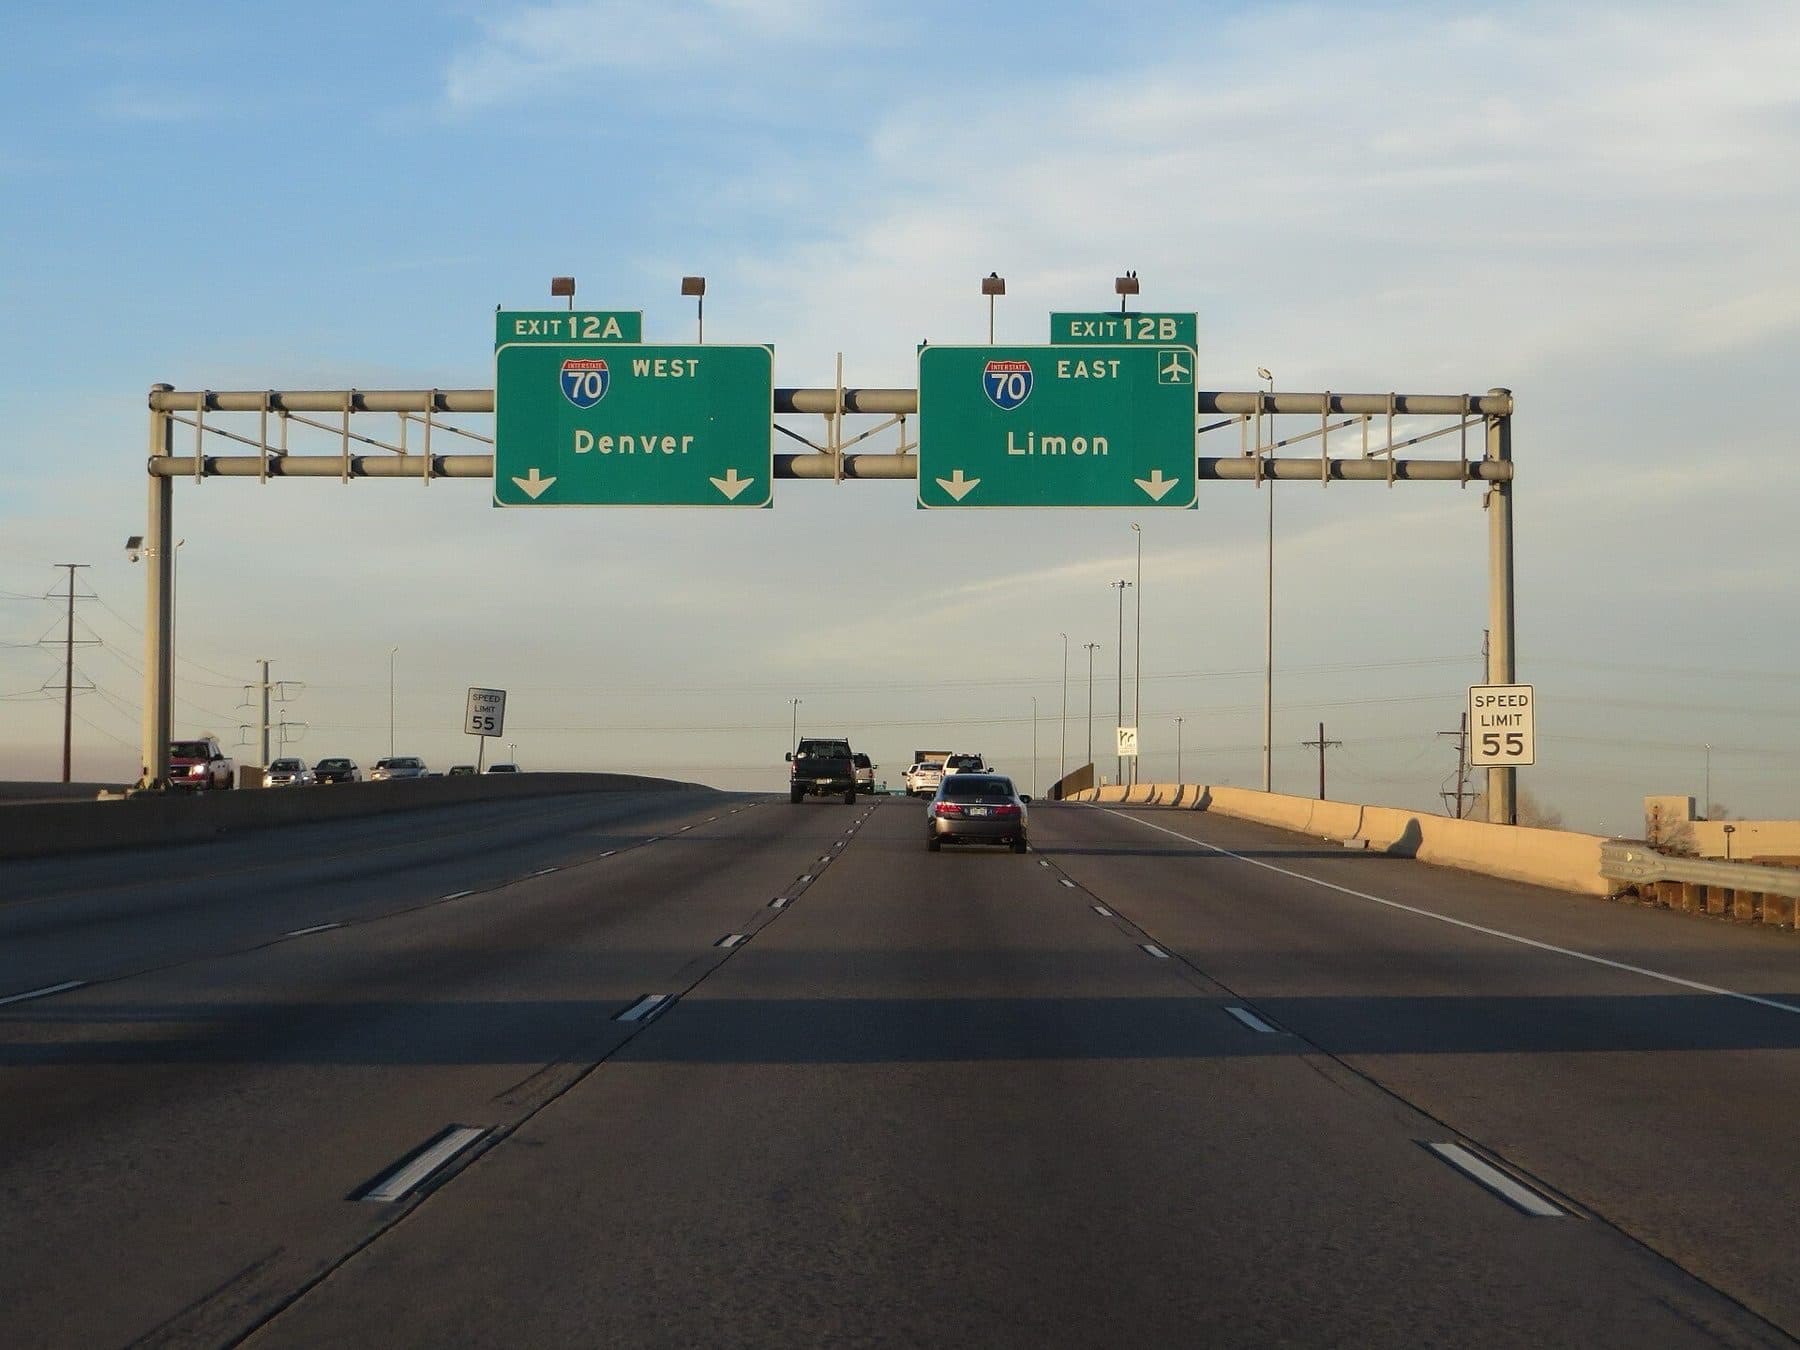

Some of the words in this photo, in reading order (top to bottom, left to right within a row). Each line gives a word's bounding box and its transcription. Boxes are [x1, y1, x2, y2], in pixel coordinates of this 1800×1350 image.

[515, 320, 562, 336] EXIT
[568, 316, 623, 339] 12A
[1071, 321, 1117, 337] EXIT
[1122, 318, 1177, 340] 12B
[633, 359, 699, 377] WEST
[990, 363, 1027, 371] INTERSTATE
[1057, 360, 1121, 379] EAST
[567, 371, 603, 399] 70
[990, 372, 1026, 400] 70
[574, 430, 694, 454] Denver
[1007, 431, 1109, 456] Limon
[472, 693, 501, 703] SPEED
[1475, 695, 1529, 708] SPEED
[472, 716, 495, 731] 55
[1481, 713, 1522, 727] LIMIT
[1482, 732, 1524, 757] 55
